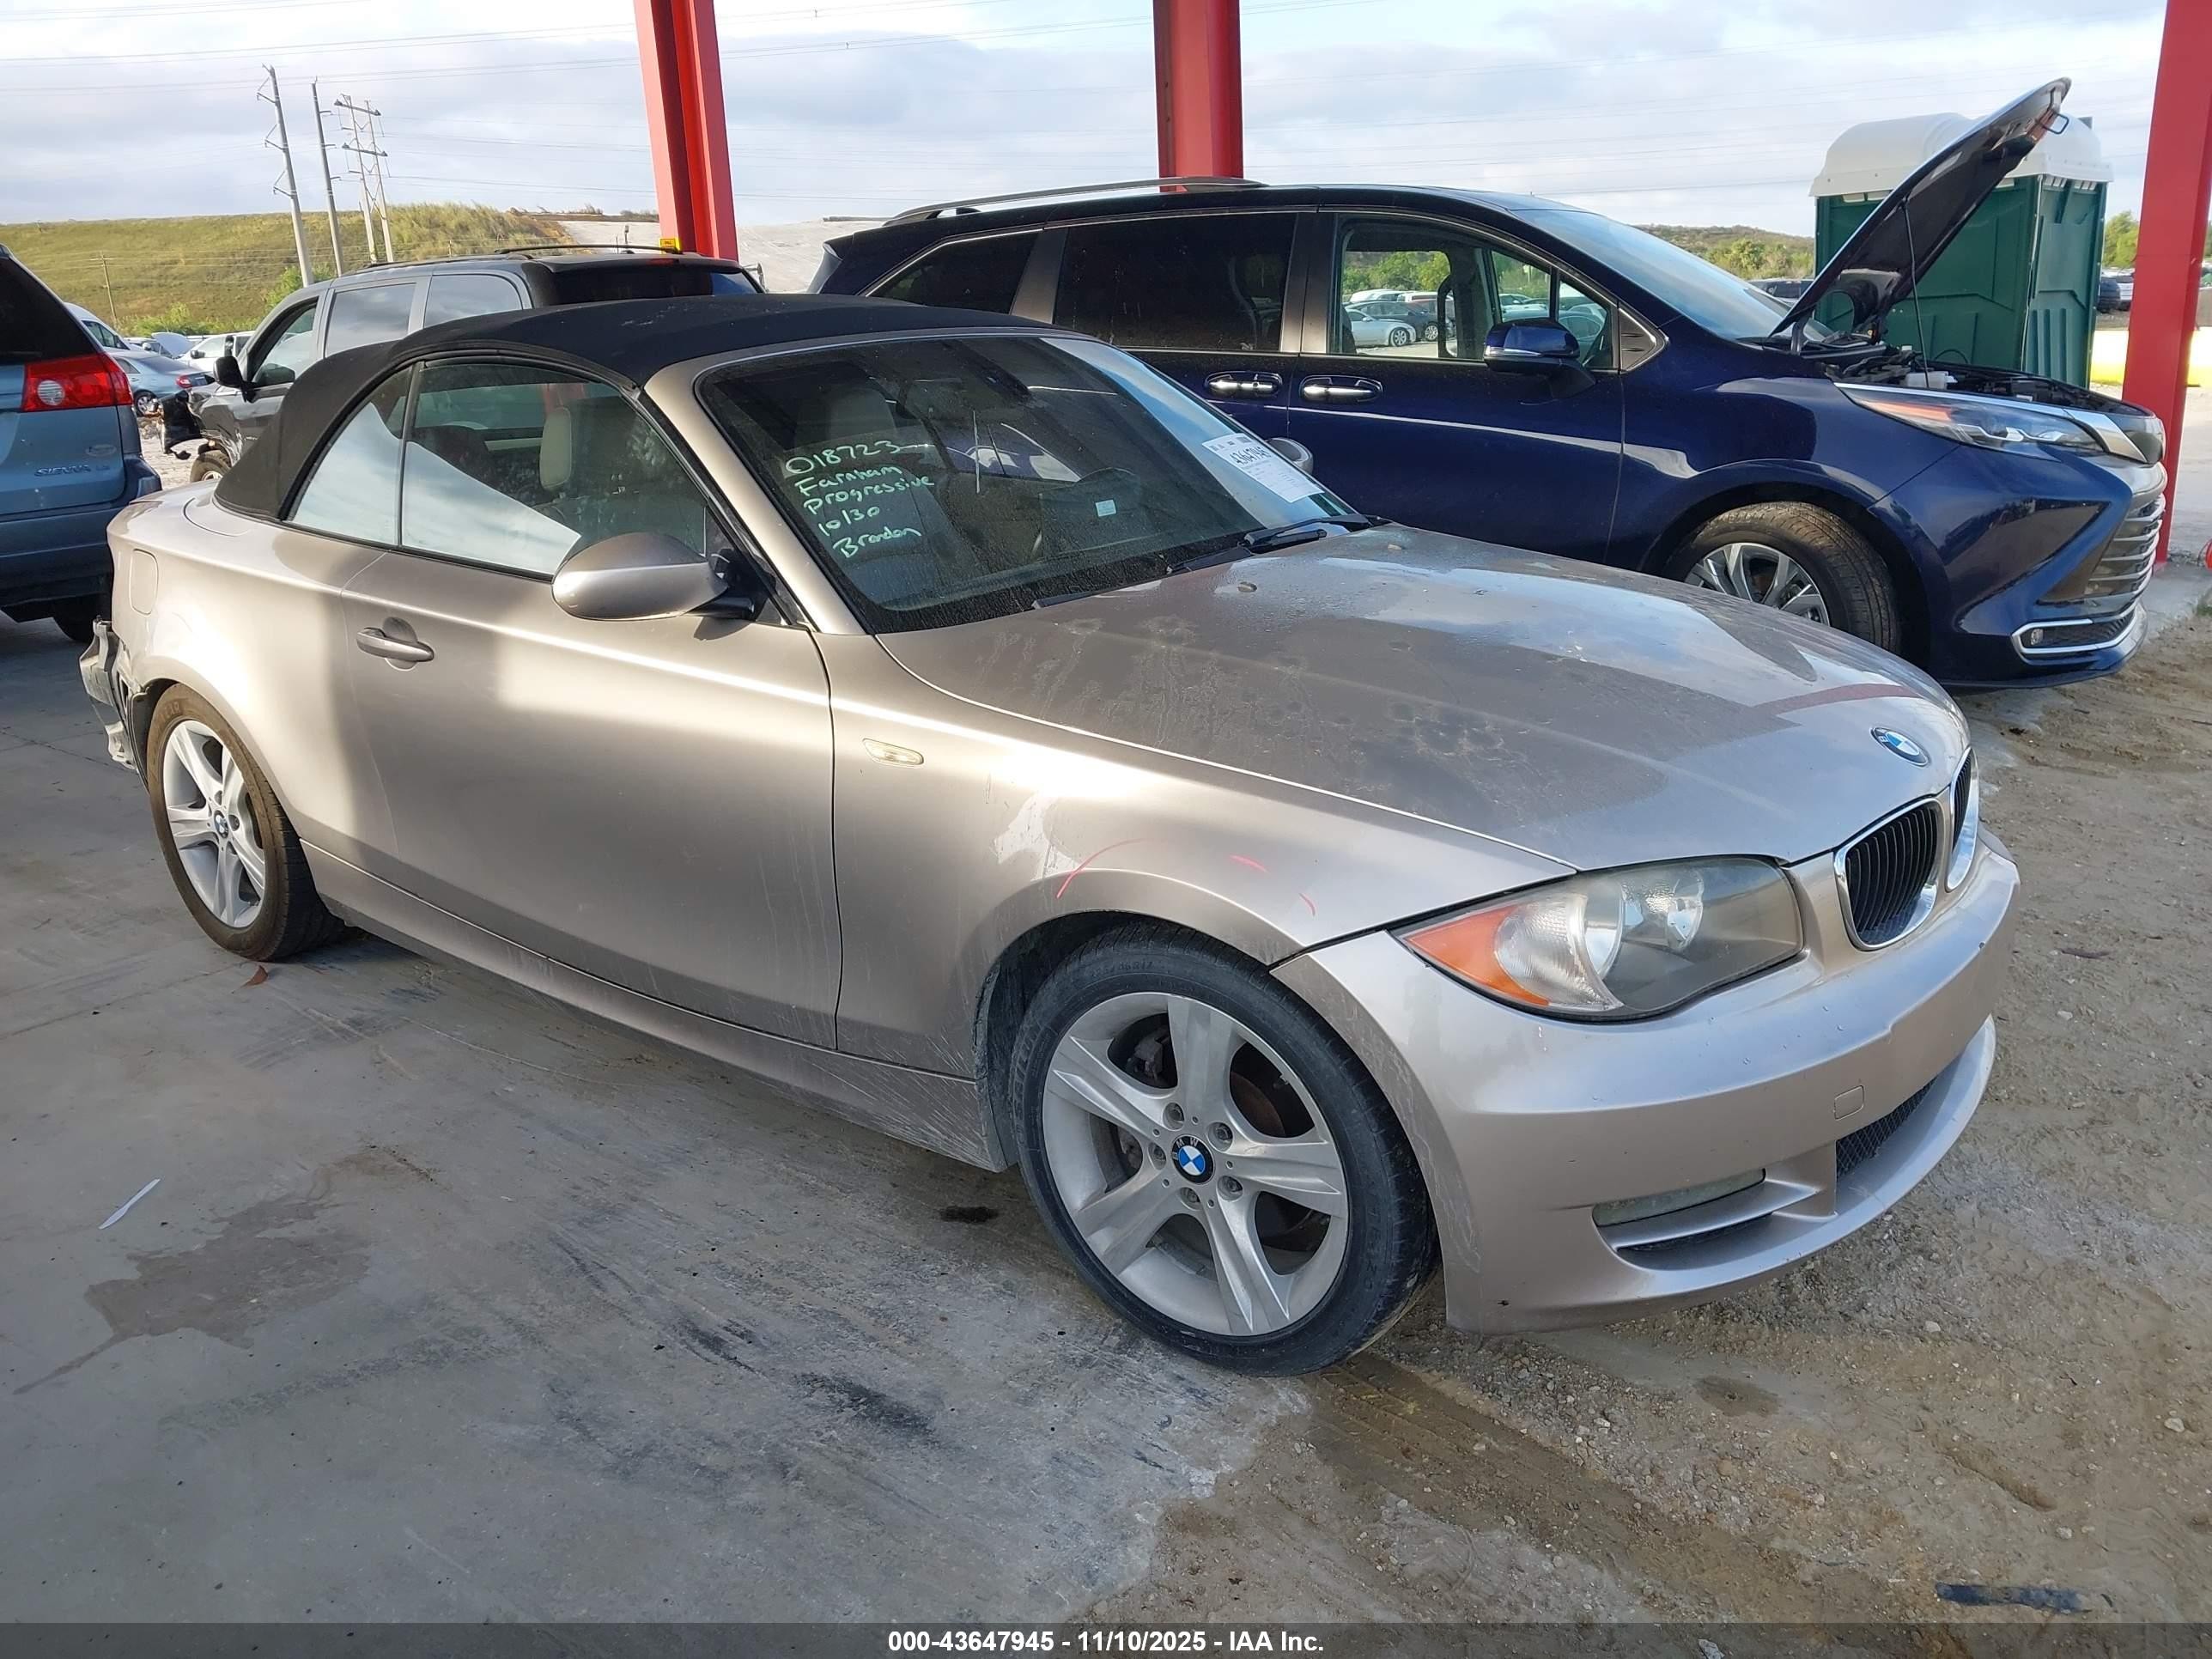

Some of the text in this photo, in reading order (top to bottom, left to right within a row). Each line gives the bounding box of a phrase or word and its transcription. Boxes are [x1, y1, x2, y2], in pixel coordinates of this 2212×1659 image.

[785, 440, 901, 474] 018723
[794, 466, 902, 496] Farnham
[818, 506, 880, 537] 10/30
